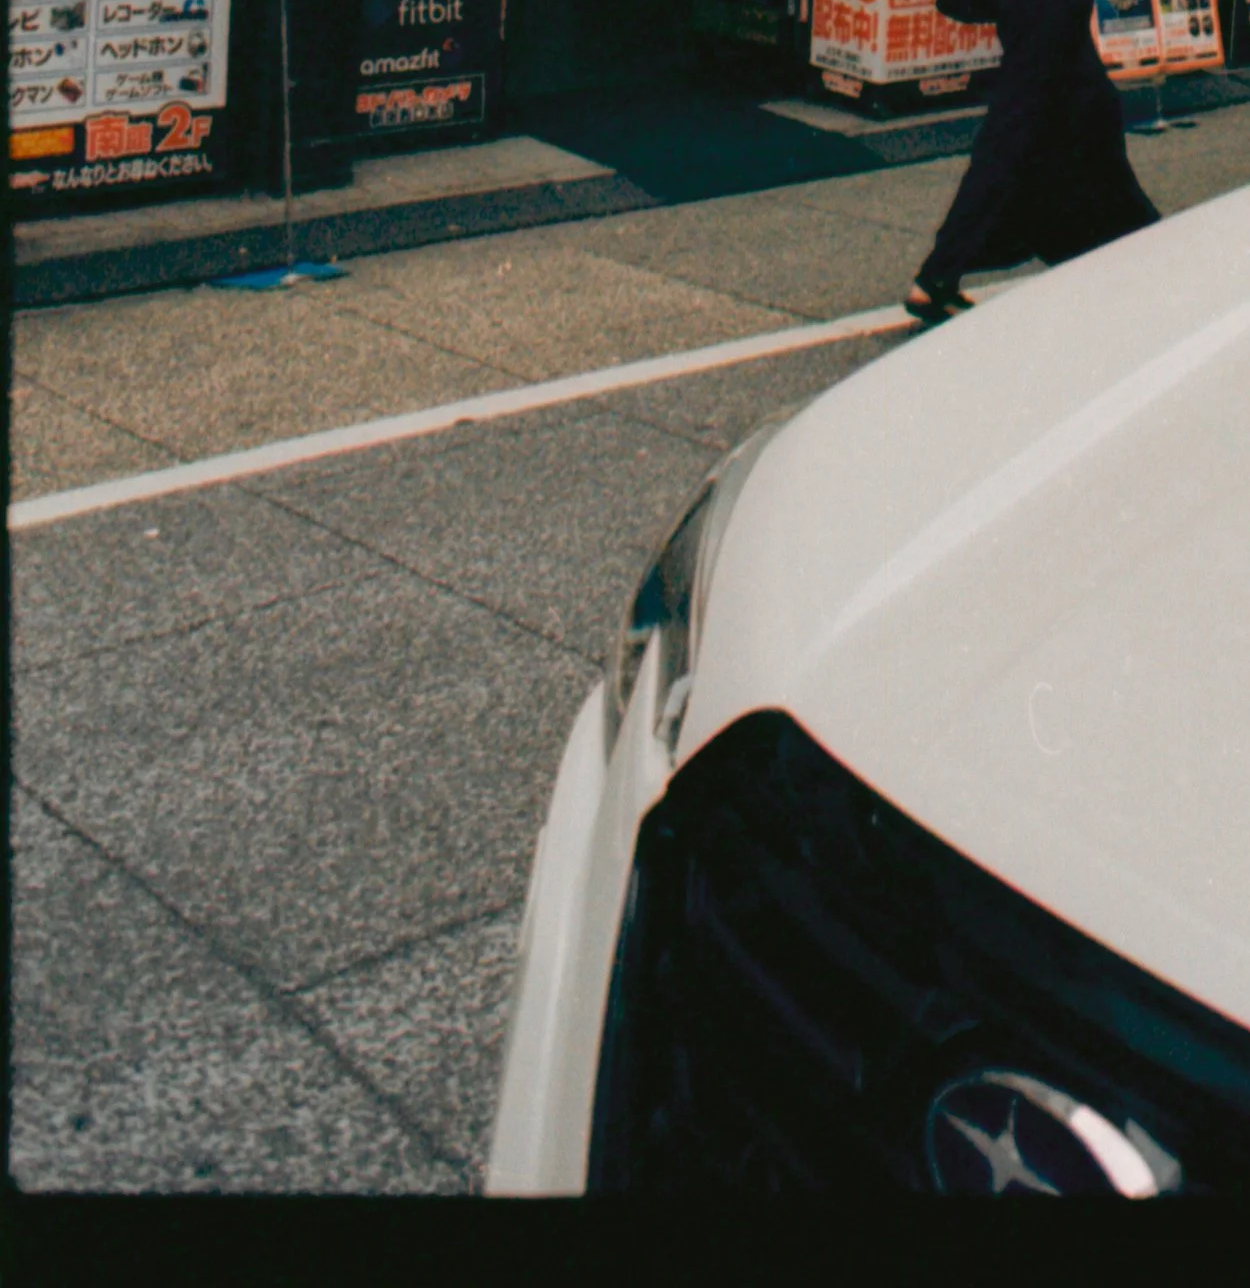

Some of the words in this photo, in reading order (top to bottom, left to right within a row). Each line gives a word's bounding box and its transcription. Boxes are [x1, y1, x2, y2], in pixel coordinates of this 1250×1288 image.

[101, 37, 184, 60] ヘッドホン
[360, 48, 440, 75] amazfit
[155, 105, 213, 153] 2F
